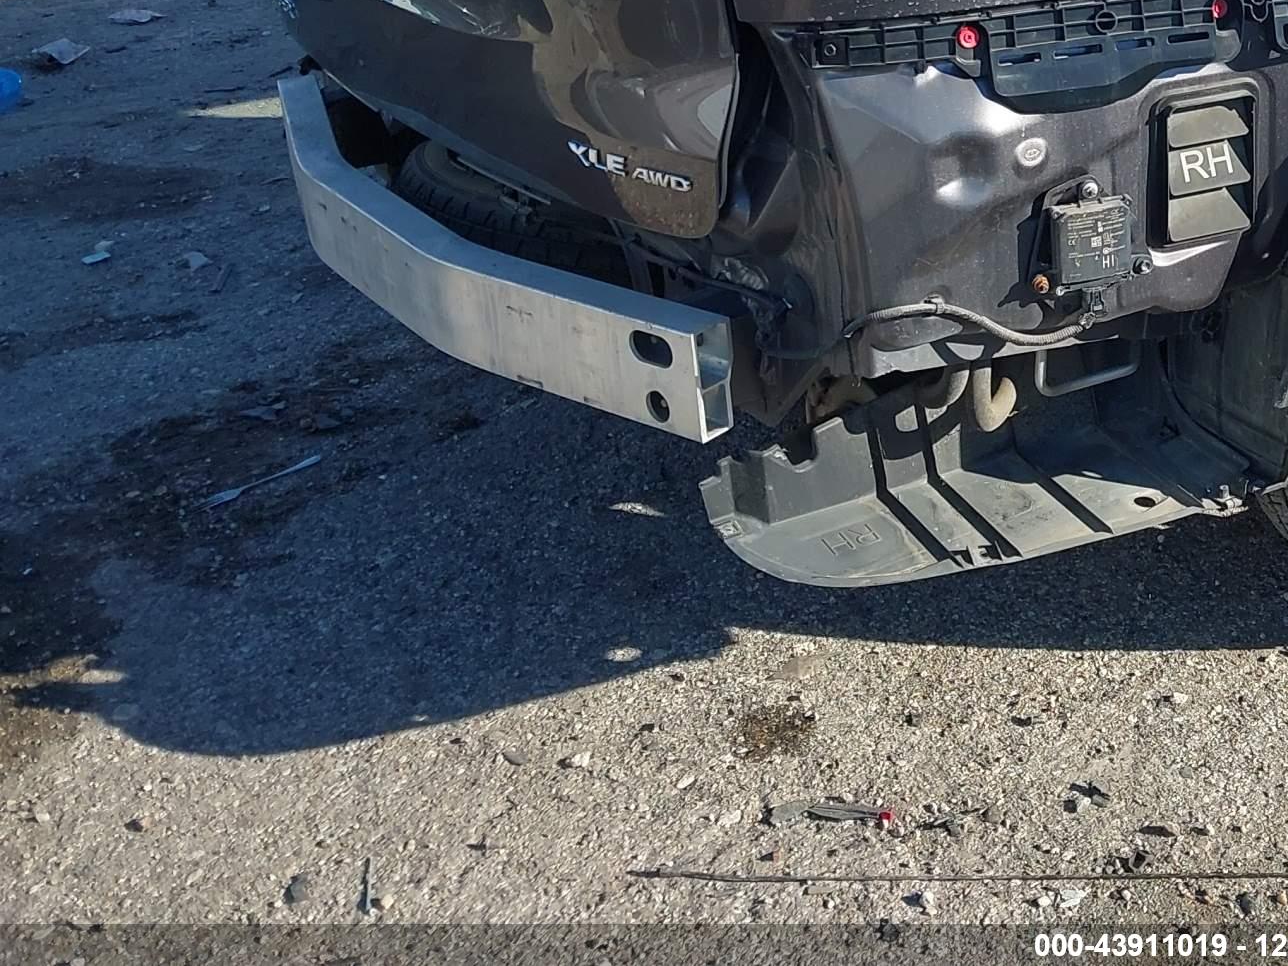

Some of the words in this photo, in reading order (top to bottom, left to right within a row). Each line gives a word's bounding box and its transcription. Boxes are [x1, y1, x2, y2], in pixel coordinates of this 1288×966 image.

[567, 139, 626, 177] XLE
[632, 167, 693, 192] AWD
[1180, 145, 1234, 183] RH
[818, 522, 883, 557] RH
